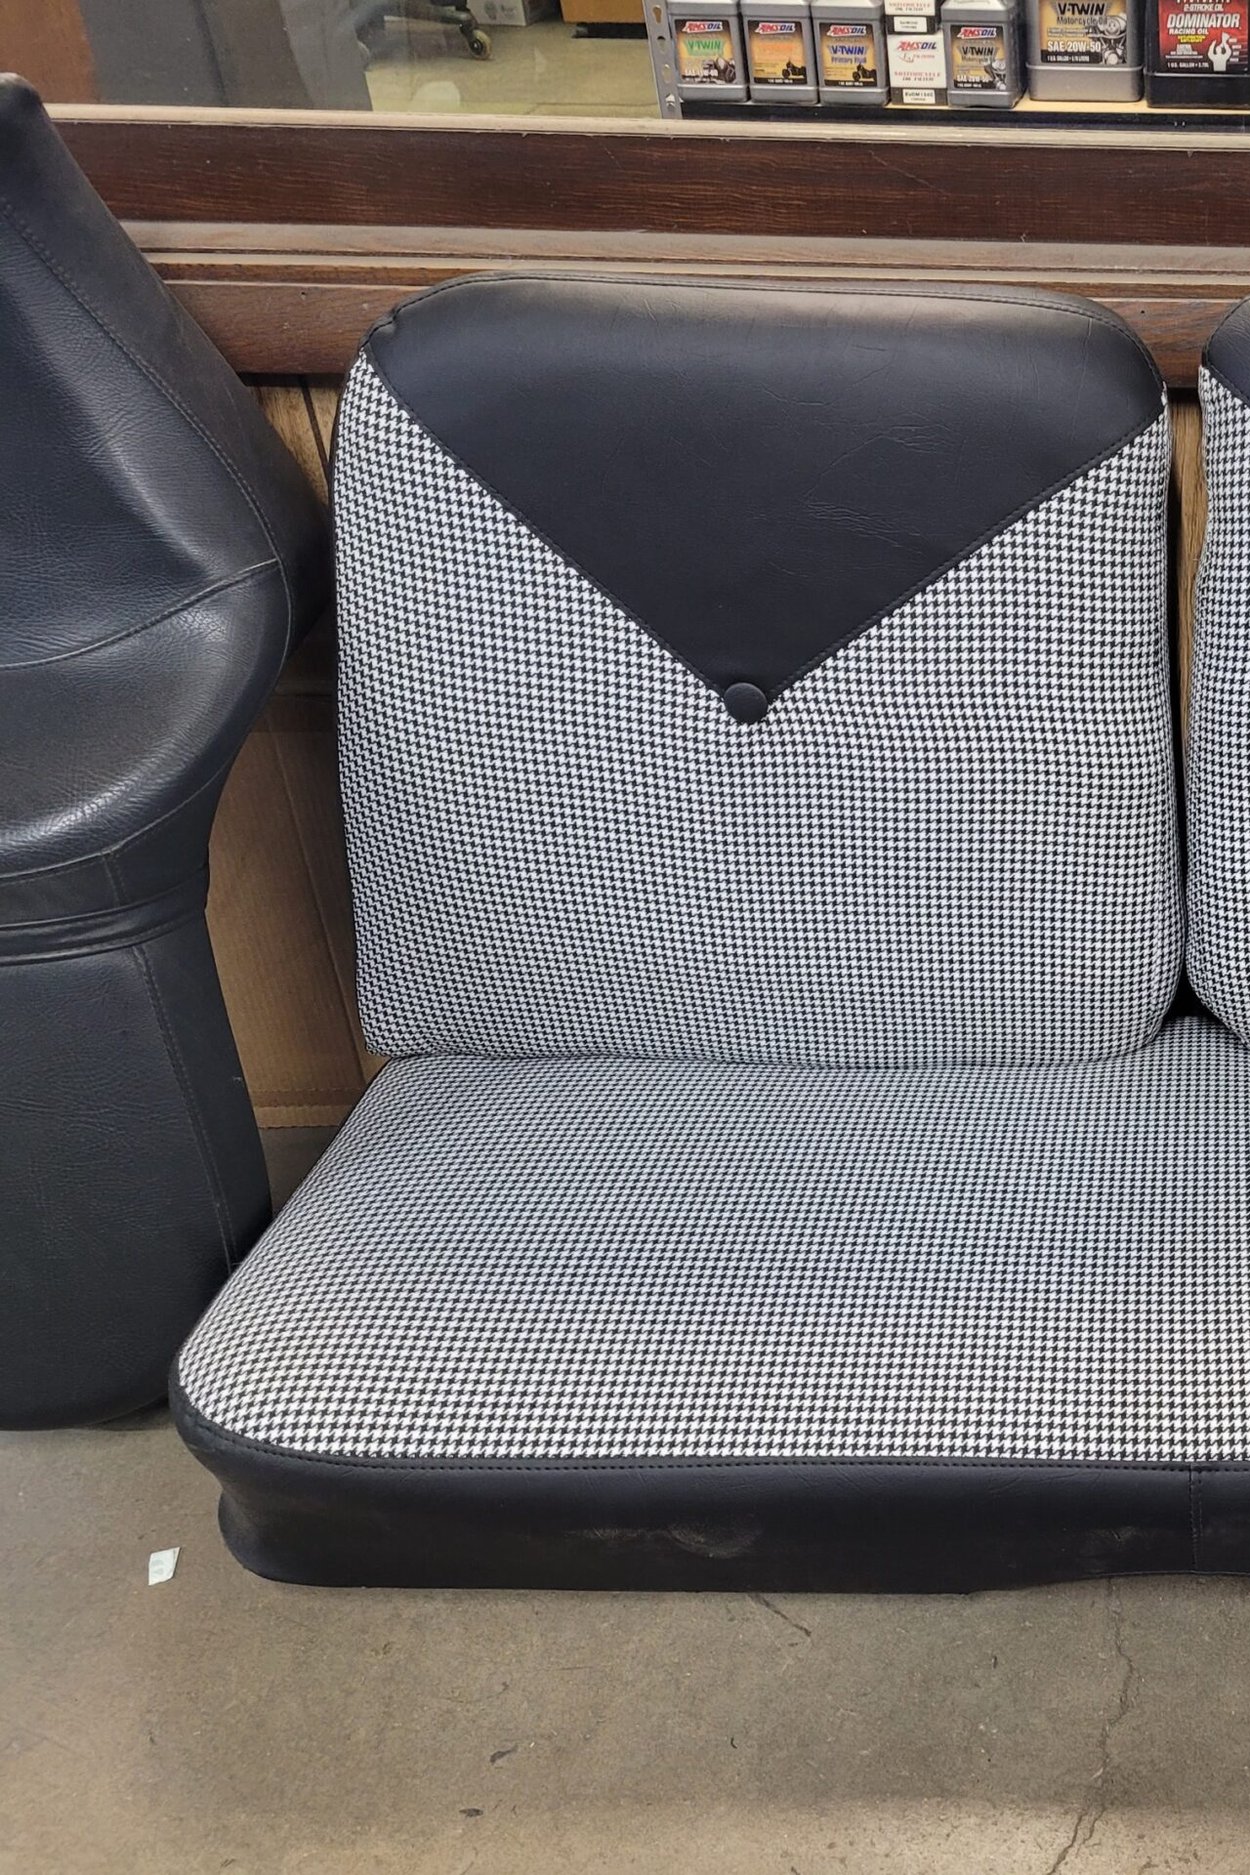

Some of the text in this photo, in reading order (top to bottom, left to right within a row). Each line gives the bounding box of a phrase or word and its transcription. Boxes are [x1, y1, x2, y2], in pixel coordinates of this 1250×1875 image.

[1057, 16, 1097, 25] Motorcycle
[1167, 13, 1240, 28] DOMINATOR
[685, 21, 722, 32] AMSOIL
[757, 23, 795, 34] AMSOIL
[829, 25, 866, 36] AMSOIL
[959, 27, 996, 38] AMSOIL
[897, 41, 937, 51] AMSOIL
[1047, 41, 1101, 52] SAE 20W-50
